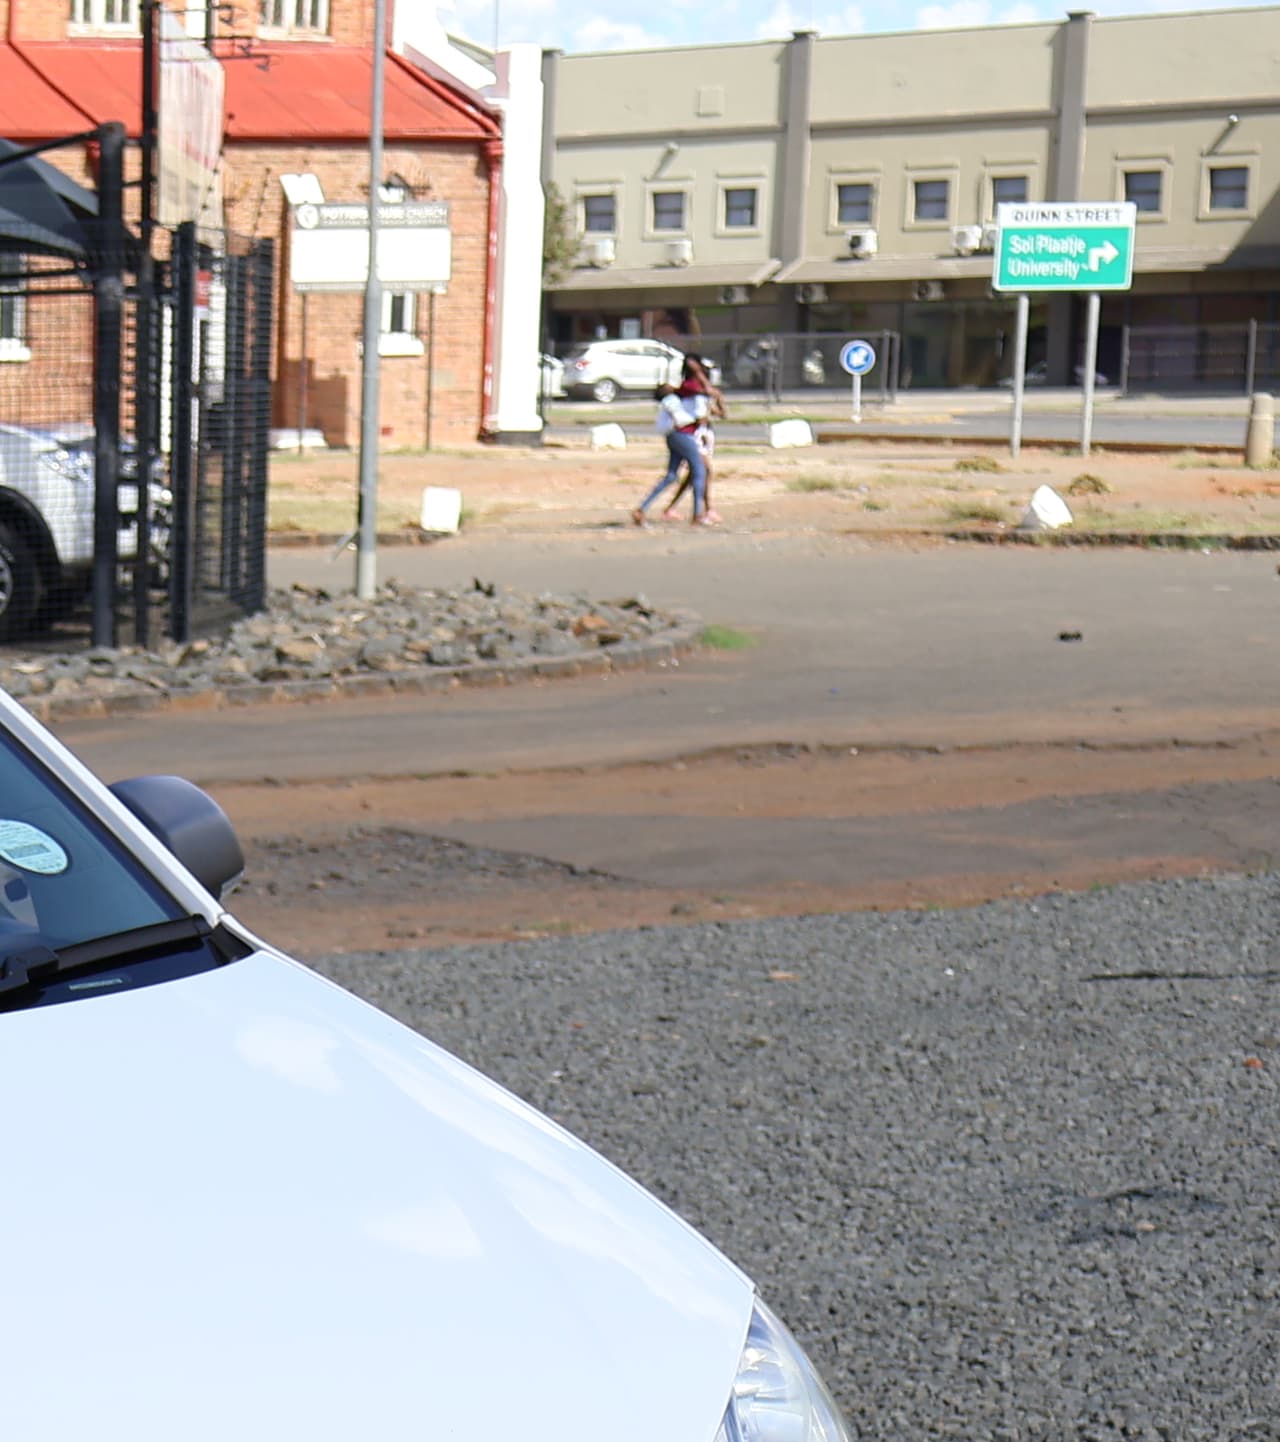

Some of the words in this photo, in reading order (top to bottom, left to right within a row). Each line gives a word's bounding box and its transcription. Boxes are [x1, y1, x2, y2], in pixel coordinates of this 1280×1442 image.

[1013, 210, 1061, 223] QUINN
[1065, 208, 1123, 222] STREET
[1009, 235, 1035, 255] Sol
[1037, 233, 1087, 258] Plaatje
[1008, 258, 1081, 280] University
